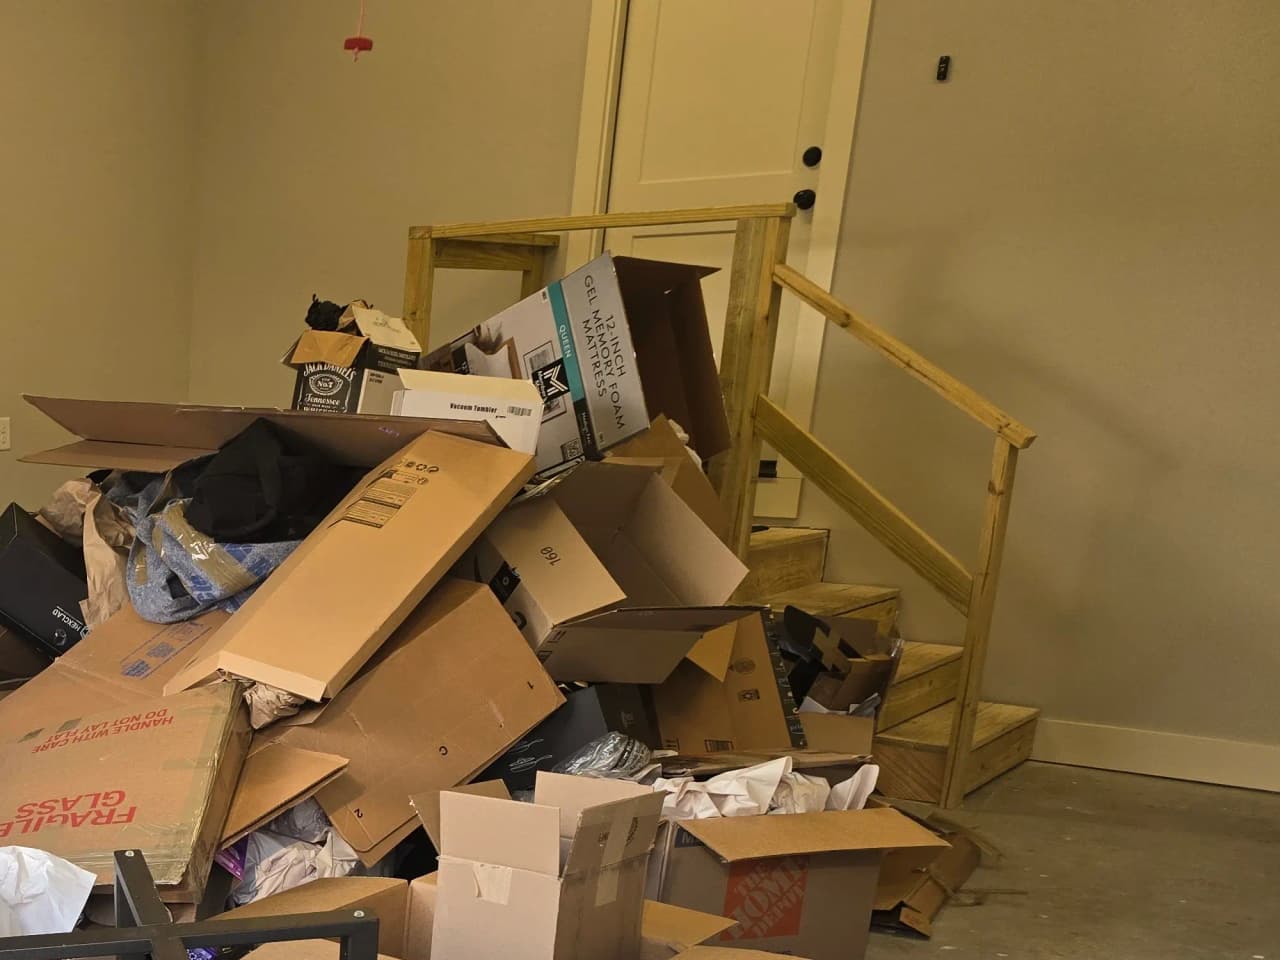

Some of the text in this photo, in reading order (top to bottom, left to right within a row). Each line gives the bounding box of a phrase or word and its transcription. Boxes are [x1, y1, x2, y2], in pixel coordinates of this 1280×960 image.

[559, 324, 572, 358] QUEEN
[582, 318, 607, 398] MATTRESS
[583, 274, 625, 430] GEL MEMORY FOAM
[605, 314, 627, 378] 12-INCH
[305, 393, 341, 406] Tennessee
[449, 402, 498, 414] Vacuum Tumbler
[52, 608, 81, 632] HEXCLAD
[31, 715, 174, 754] HANDLE WITH CARE
[45, 707, 168, 744] DO NOT LAY FLAT
[15, 789, 126, 820] GLASS
[353, 808, 363, 819] 2
